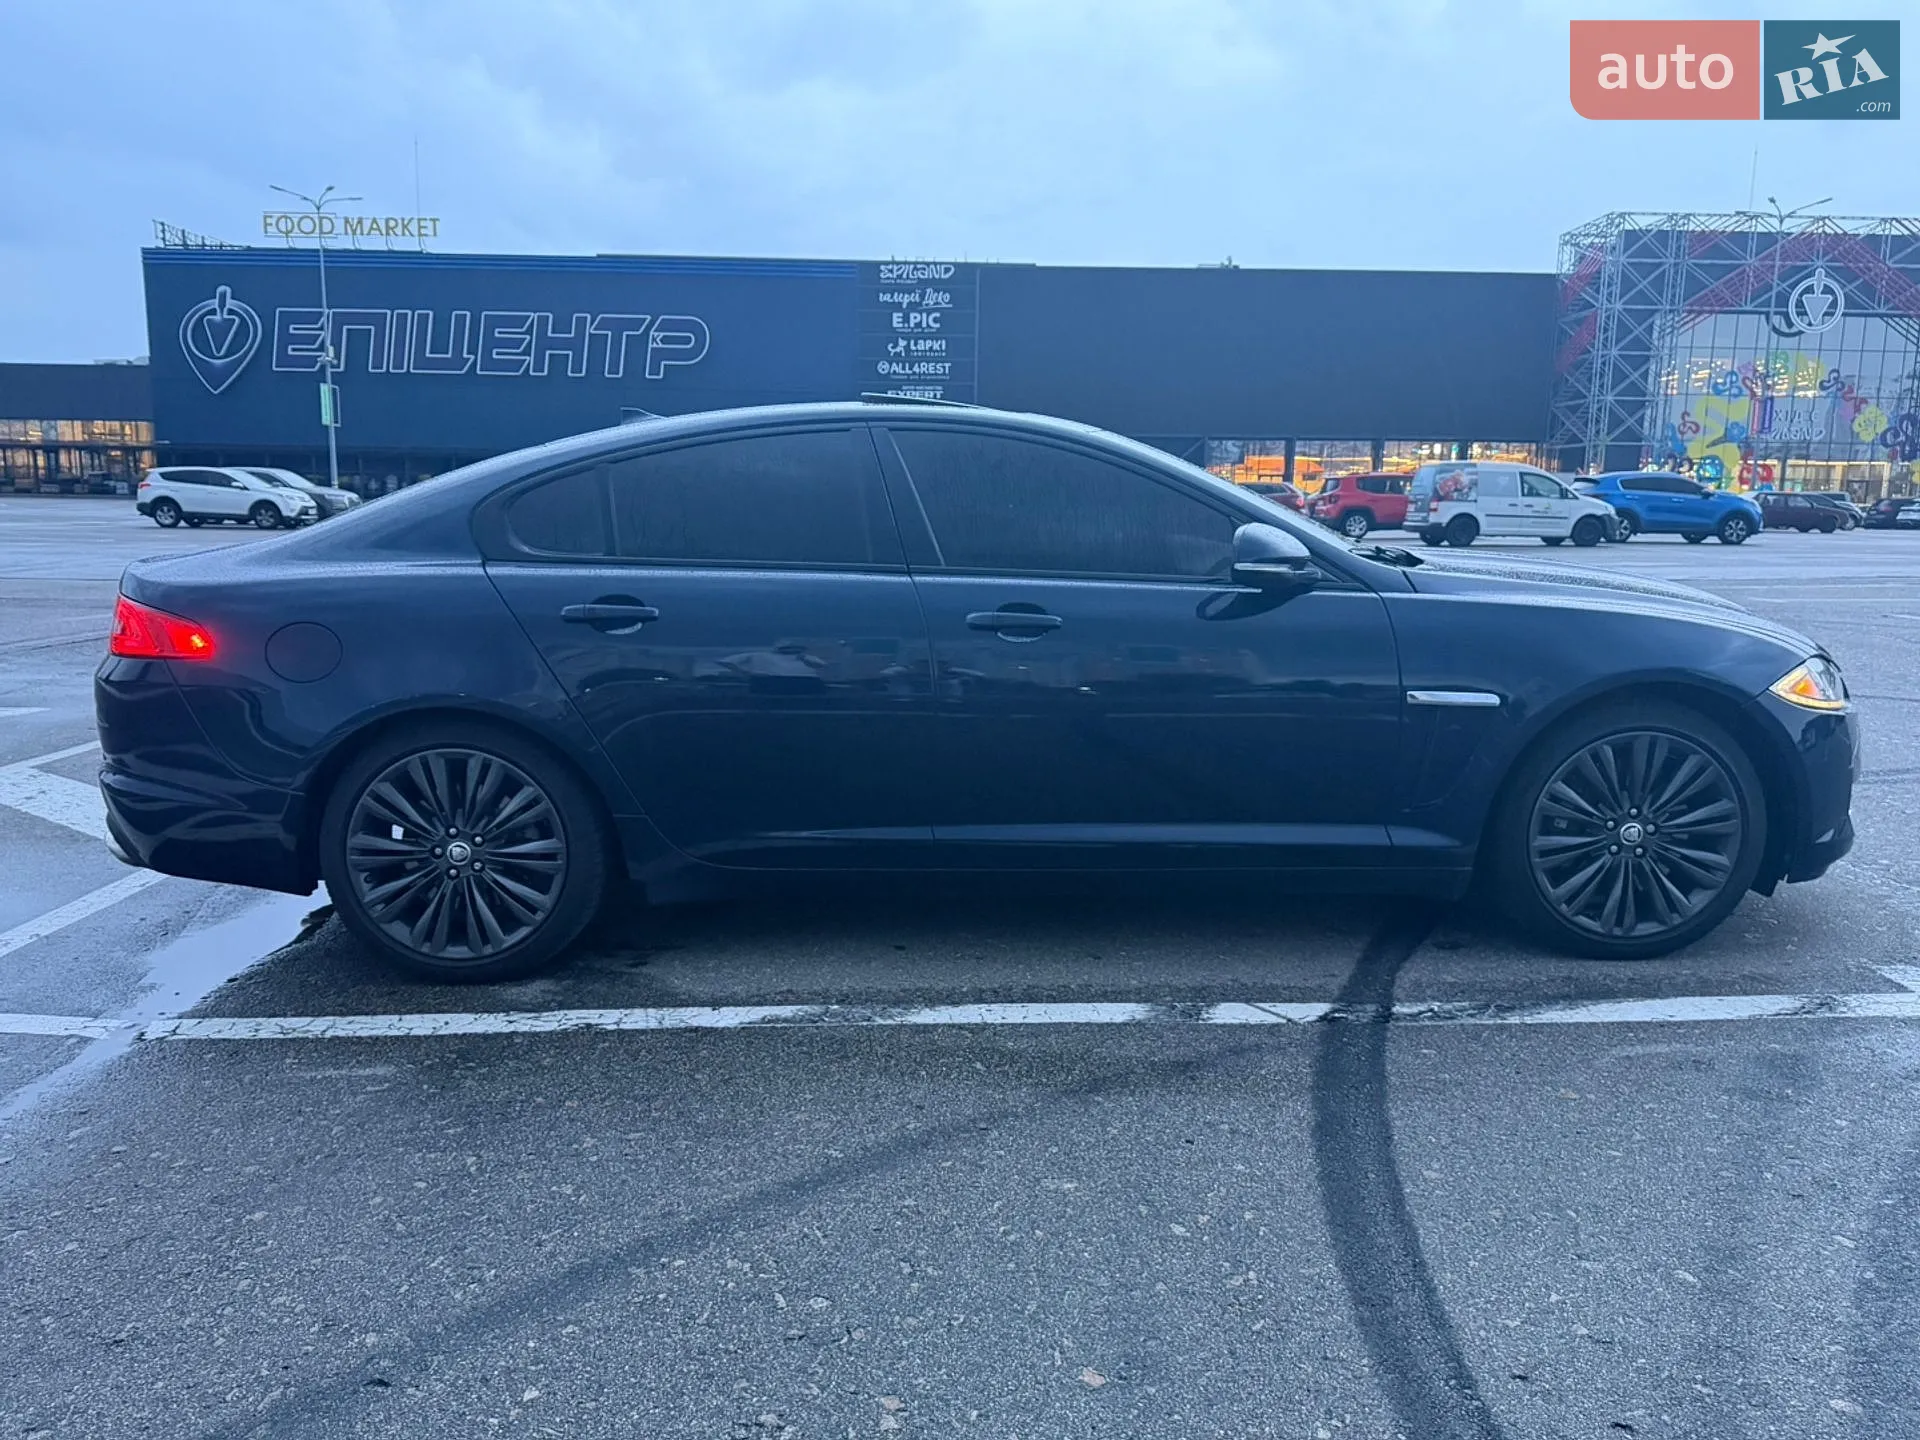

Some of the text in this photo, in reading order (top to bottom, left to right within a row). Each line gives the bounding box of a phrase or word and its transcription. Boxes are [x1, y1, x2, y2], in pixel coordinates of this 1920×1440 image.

[263, 214, 440, 237] FOOD MARKET
[892, 311, 941, 327] E.PIC
[272, 307, 711, 379] ЕПІЦЕНТР
[890, 362, 952, 374] ALL4REST
